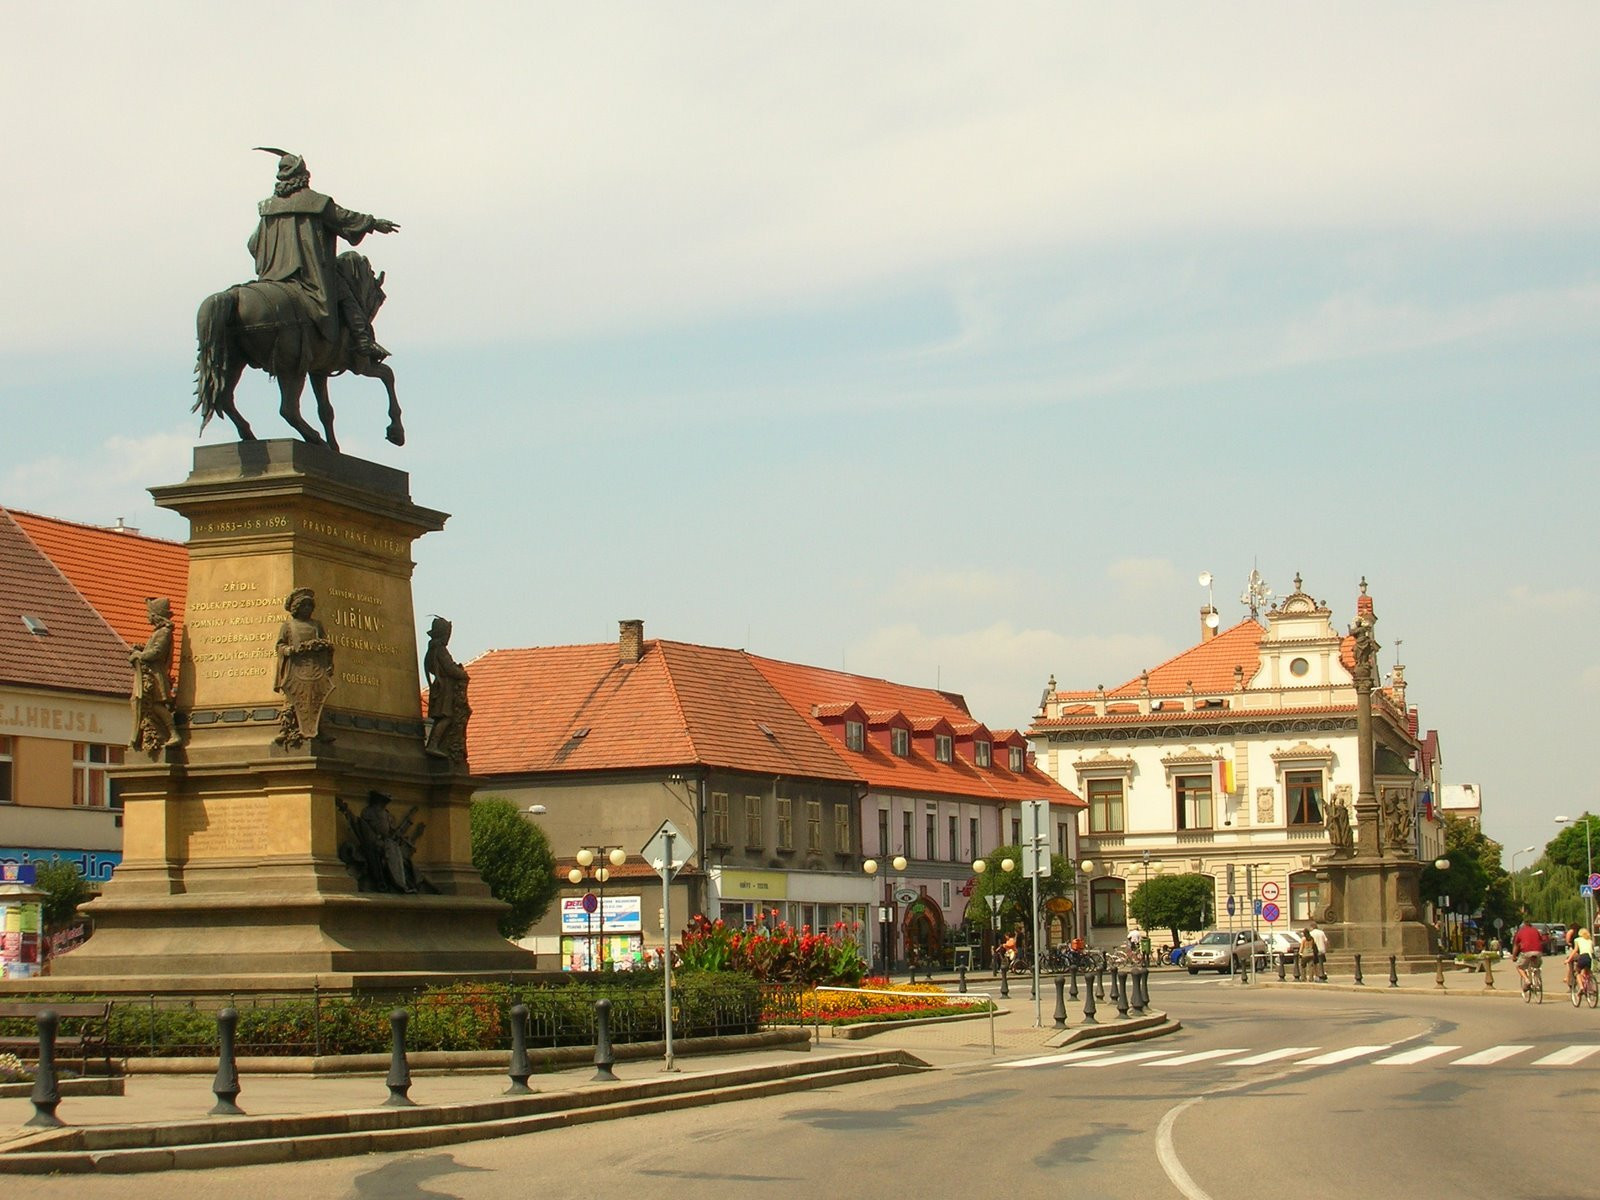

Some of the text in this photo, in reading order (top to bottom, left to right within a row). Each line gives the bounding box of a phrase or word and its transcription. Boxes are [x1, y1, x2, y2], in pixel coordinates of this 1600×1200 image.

[302, 519, 338, 537] PRAVDA
[223, 581, 257, 592] ZŘÍDIL
[191, 601, 221, 611] SPOLEK
[222, 600, 238, 610] PRO
[227, 665, 267, 677] ČESKÉHO
